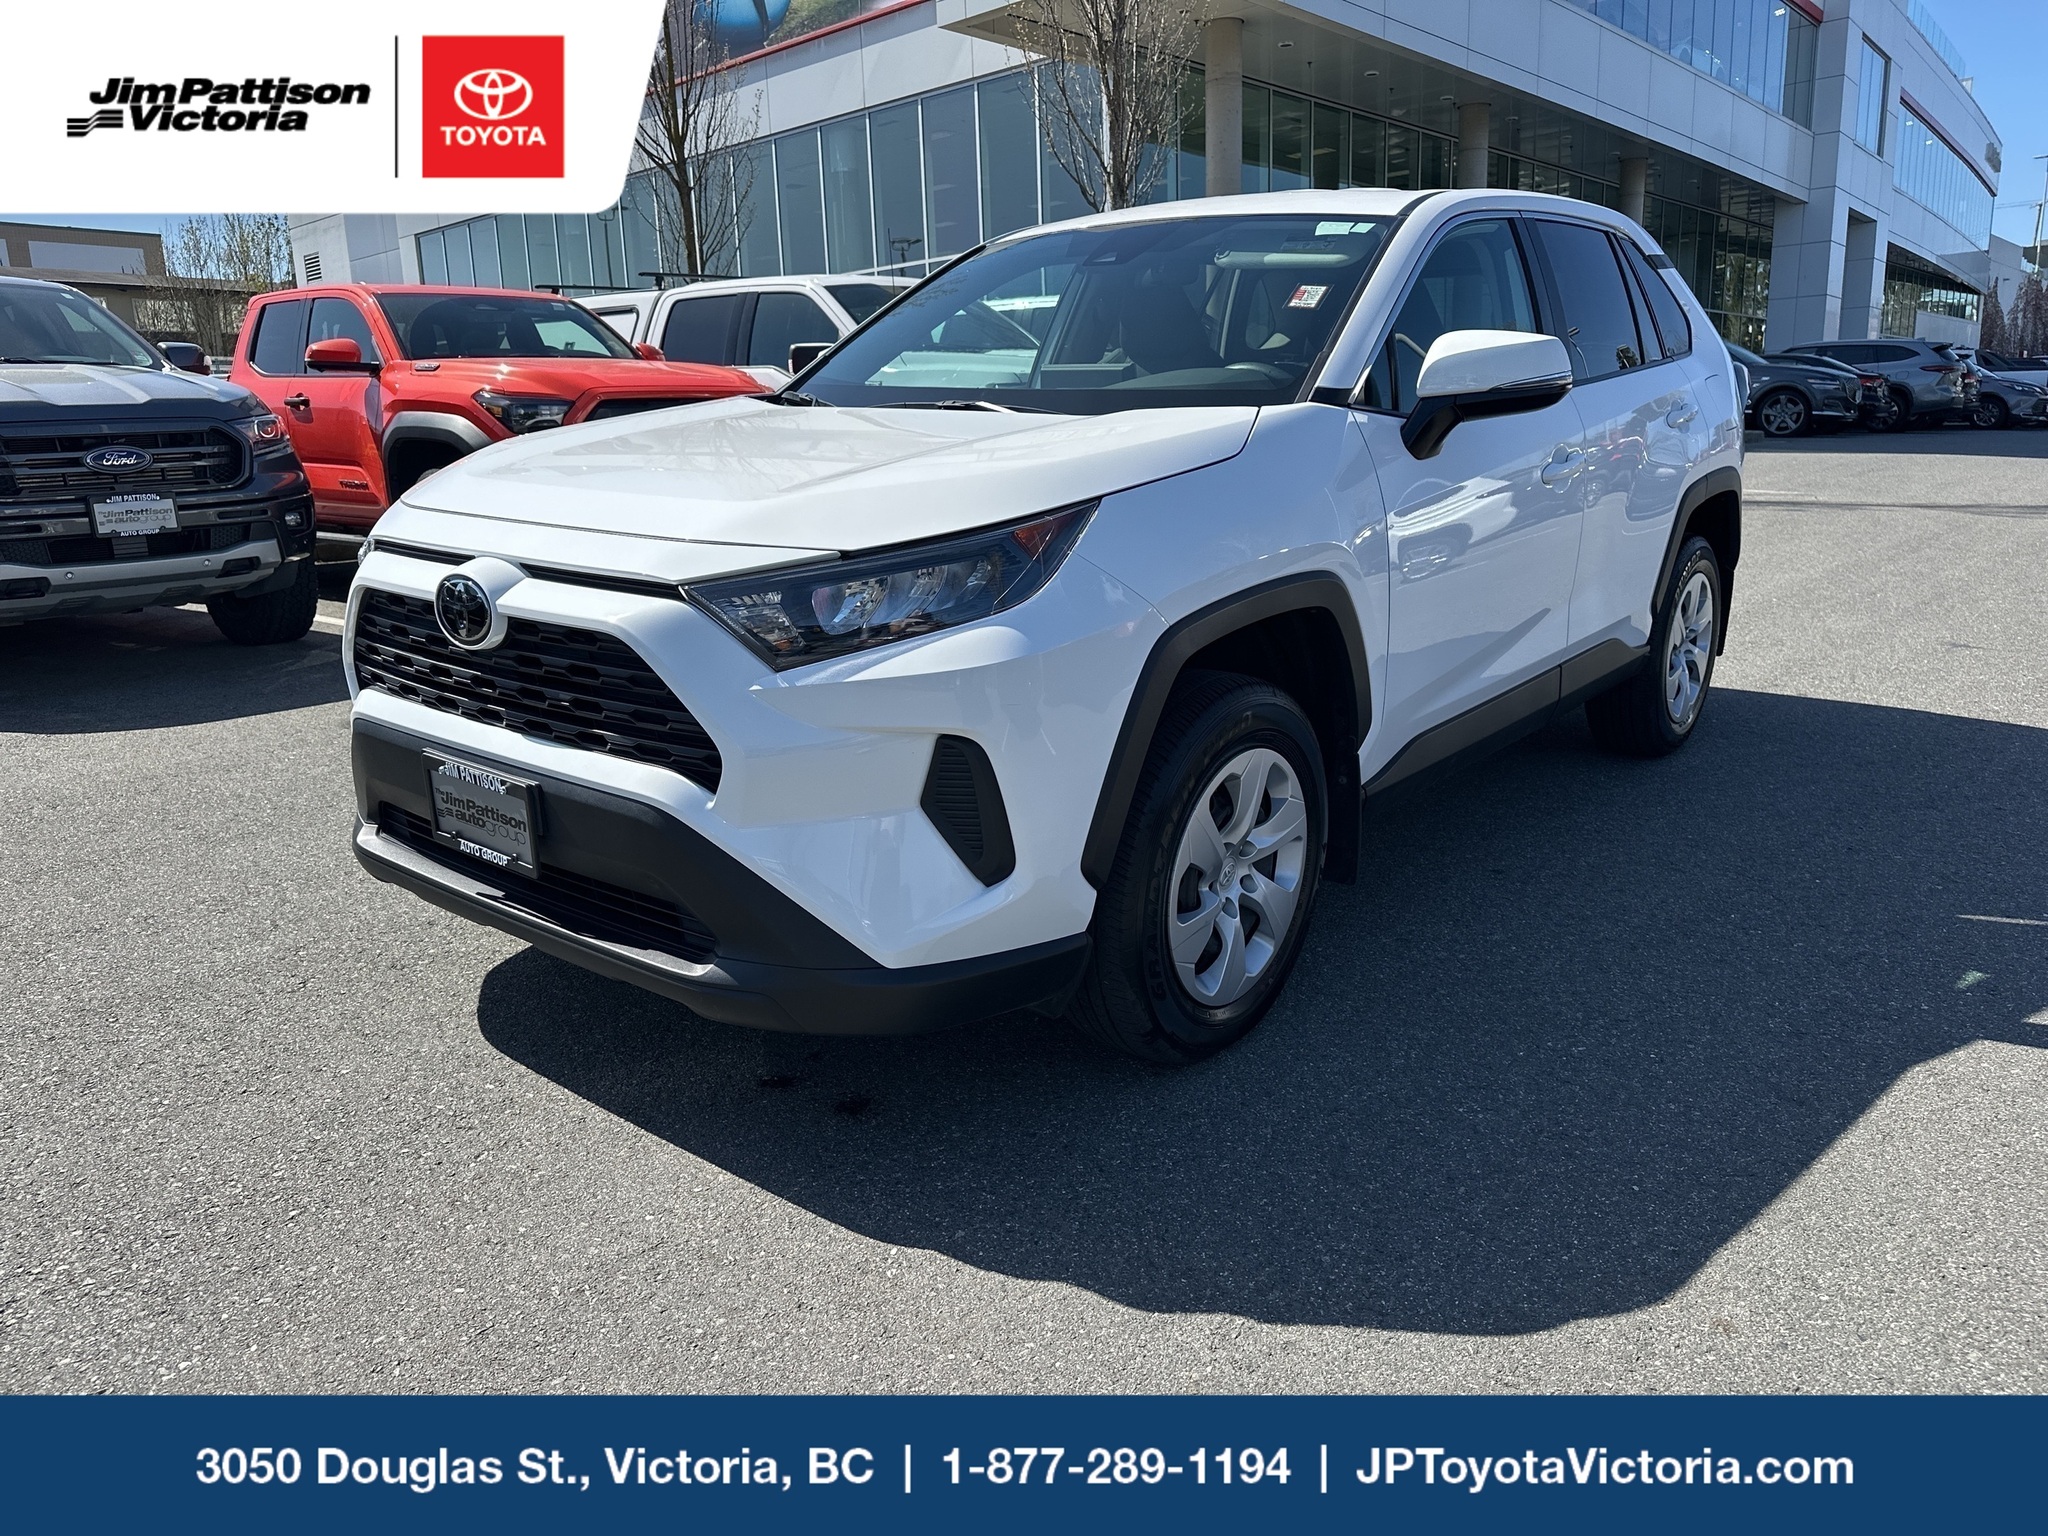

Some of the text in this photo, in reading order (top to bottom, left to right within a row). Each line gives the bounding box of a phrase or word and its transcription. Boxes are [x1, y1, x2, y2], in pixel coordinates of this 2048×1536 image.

[103, 451, 137, 466] Ford
[111, 493, 156, 503] JIM PATTISON
[139, 528, 159, 536] GROUP
[444, 762, 502, 793] JIM PATTISON
[460, 840, 508, 867] AUTO GROUP
